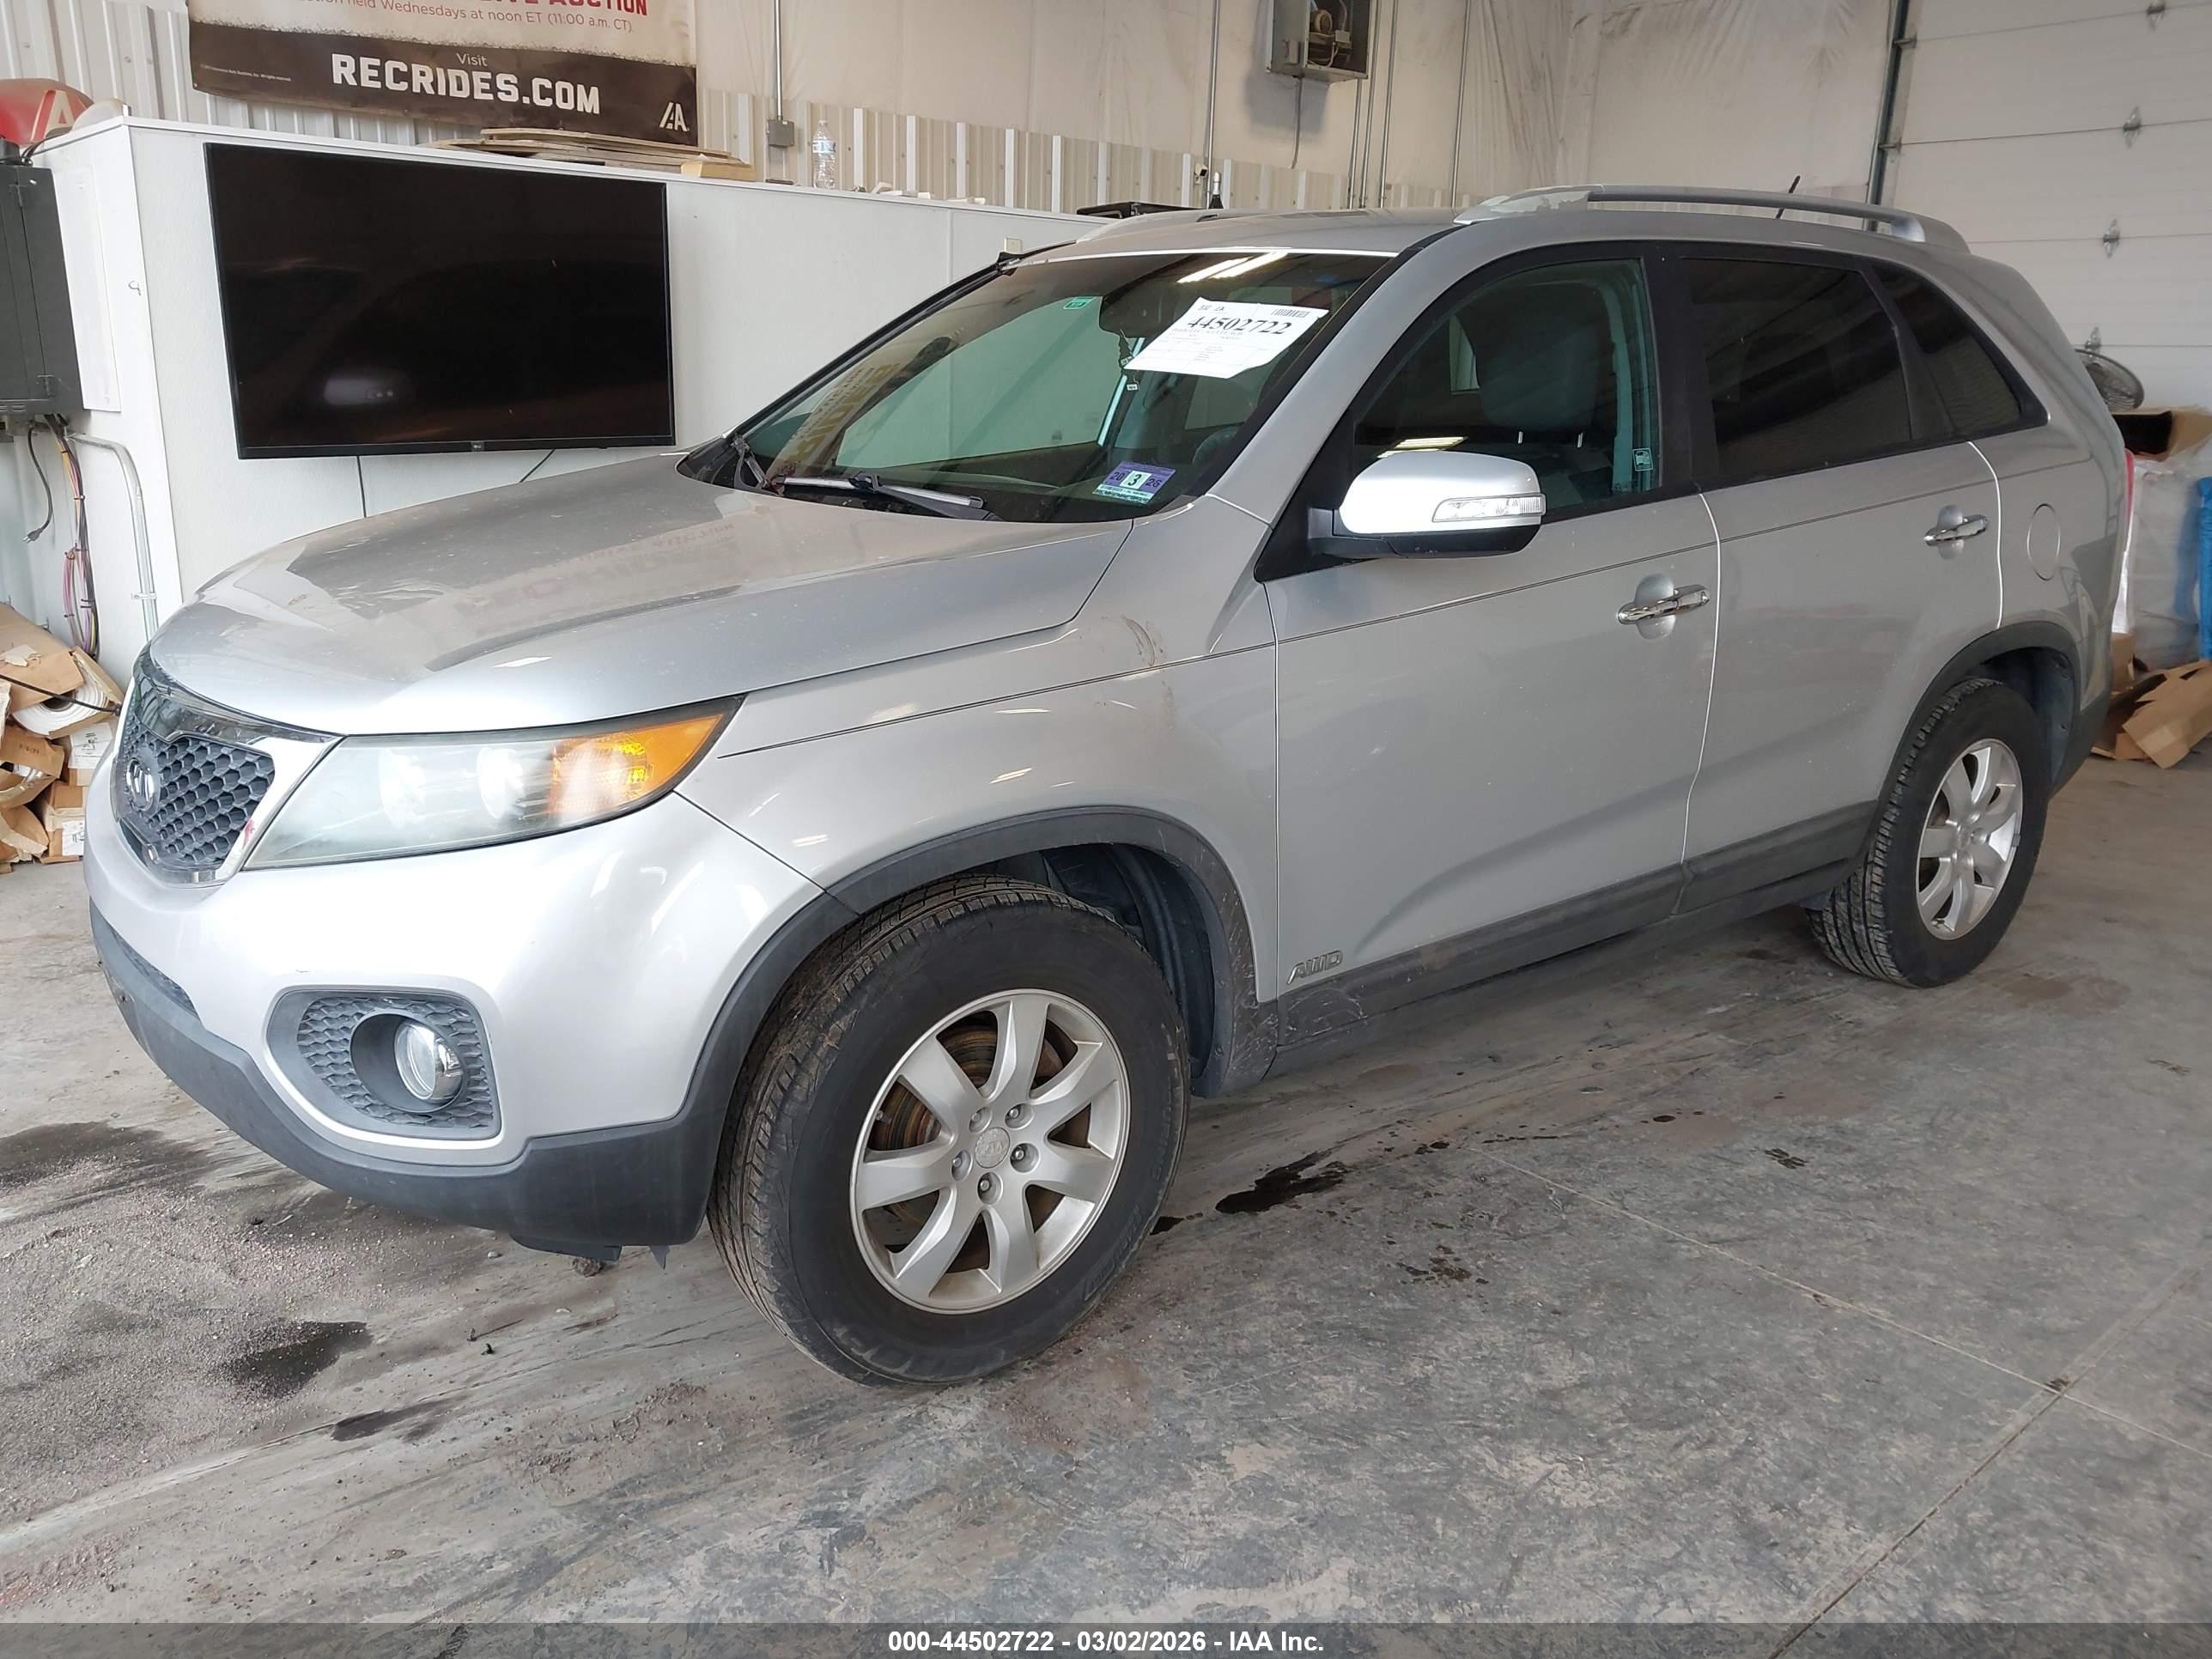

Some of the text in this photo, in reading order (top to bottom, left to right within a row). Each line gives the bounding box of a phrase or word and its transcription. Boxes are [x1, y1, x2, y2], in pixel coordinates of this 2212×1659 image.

[381, 0, 466, 19] Wednesdays
[471, 9, 484, 19] at
[488, 10, 522, 21] noon
[526, 11, 543, 23] ET
[548, 12, 585, 26] (11:00
[589, 16, 611, 28] a.m.
[456, 52, 488, 66] Visit
[331, 53, 600, 114] RECRIDES.COM
[1187, 315, 1292, 335] 44502722
[1109, 471, 1126, 482] 20
[1127, 473, 1142, 486] 3
